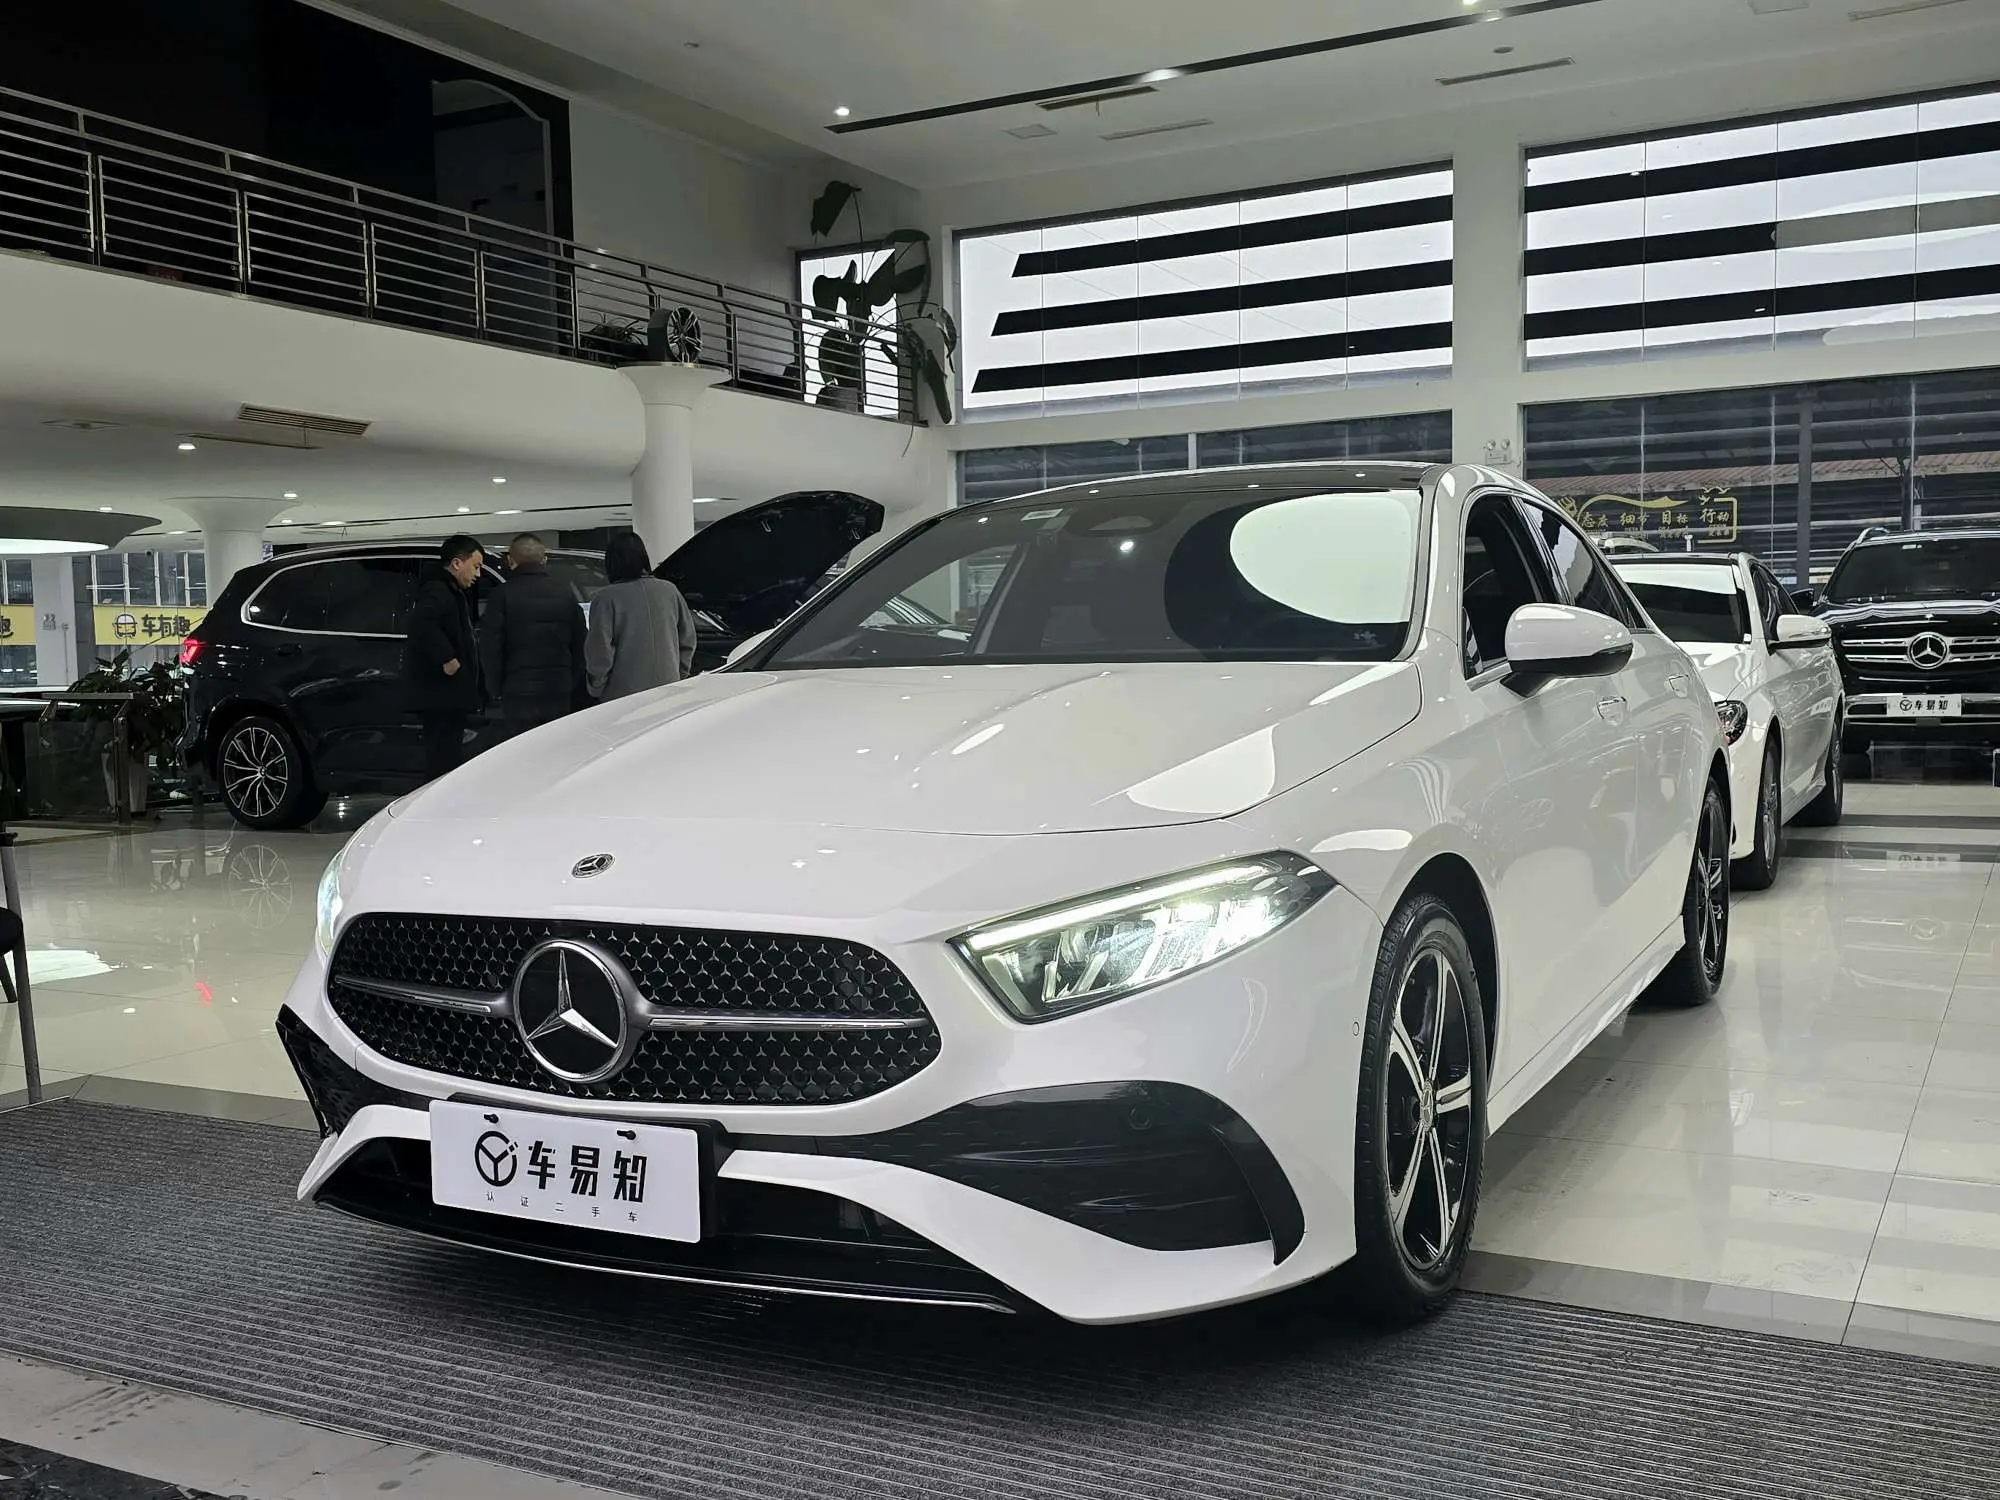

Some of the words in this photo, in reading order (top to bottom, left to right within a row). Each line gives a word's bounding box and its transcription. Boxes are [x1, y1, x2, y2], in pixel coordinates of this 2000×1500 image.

[1661, 510, 1689, 525] 目标
[1700, 508, 1730, 524] 行动
[141, 614, 190, 637] 车有趣
[527, 1140, 647, 1203] 车易知
[486, 1191, 638, 1223] 认证二手车
